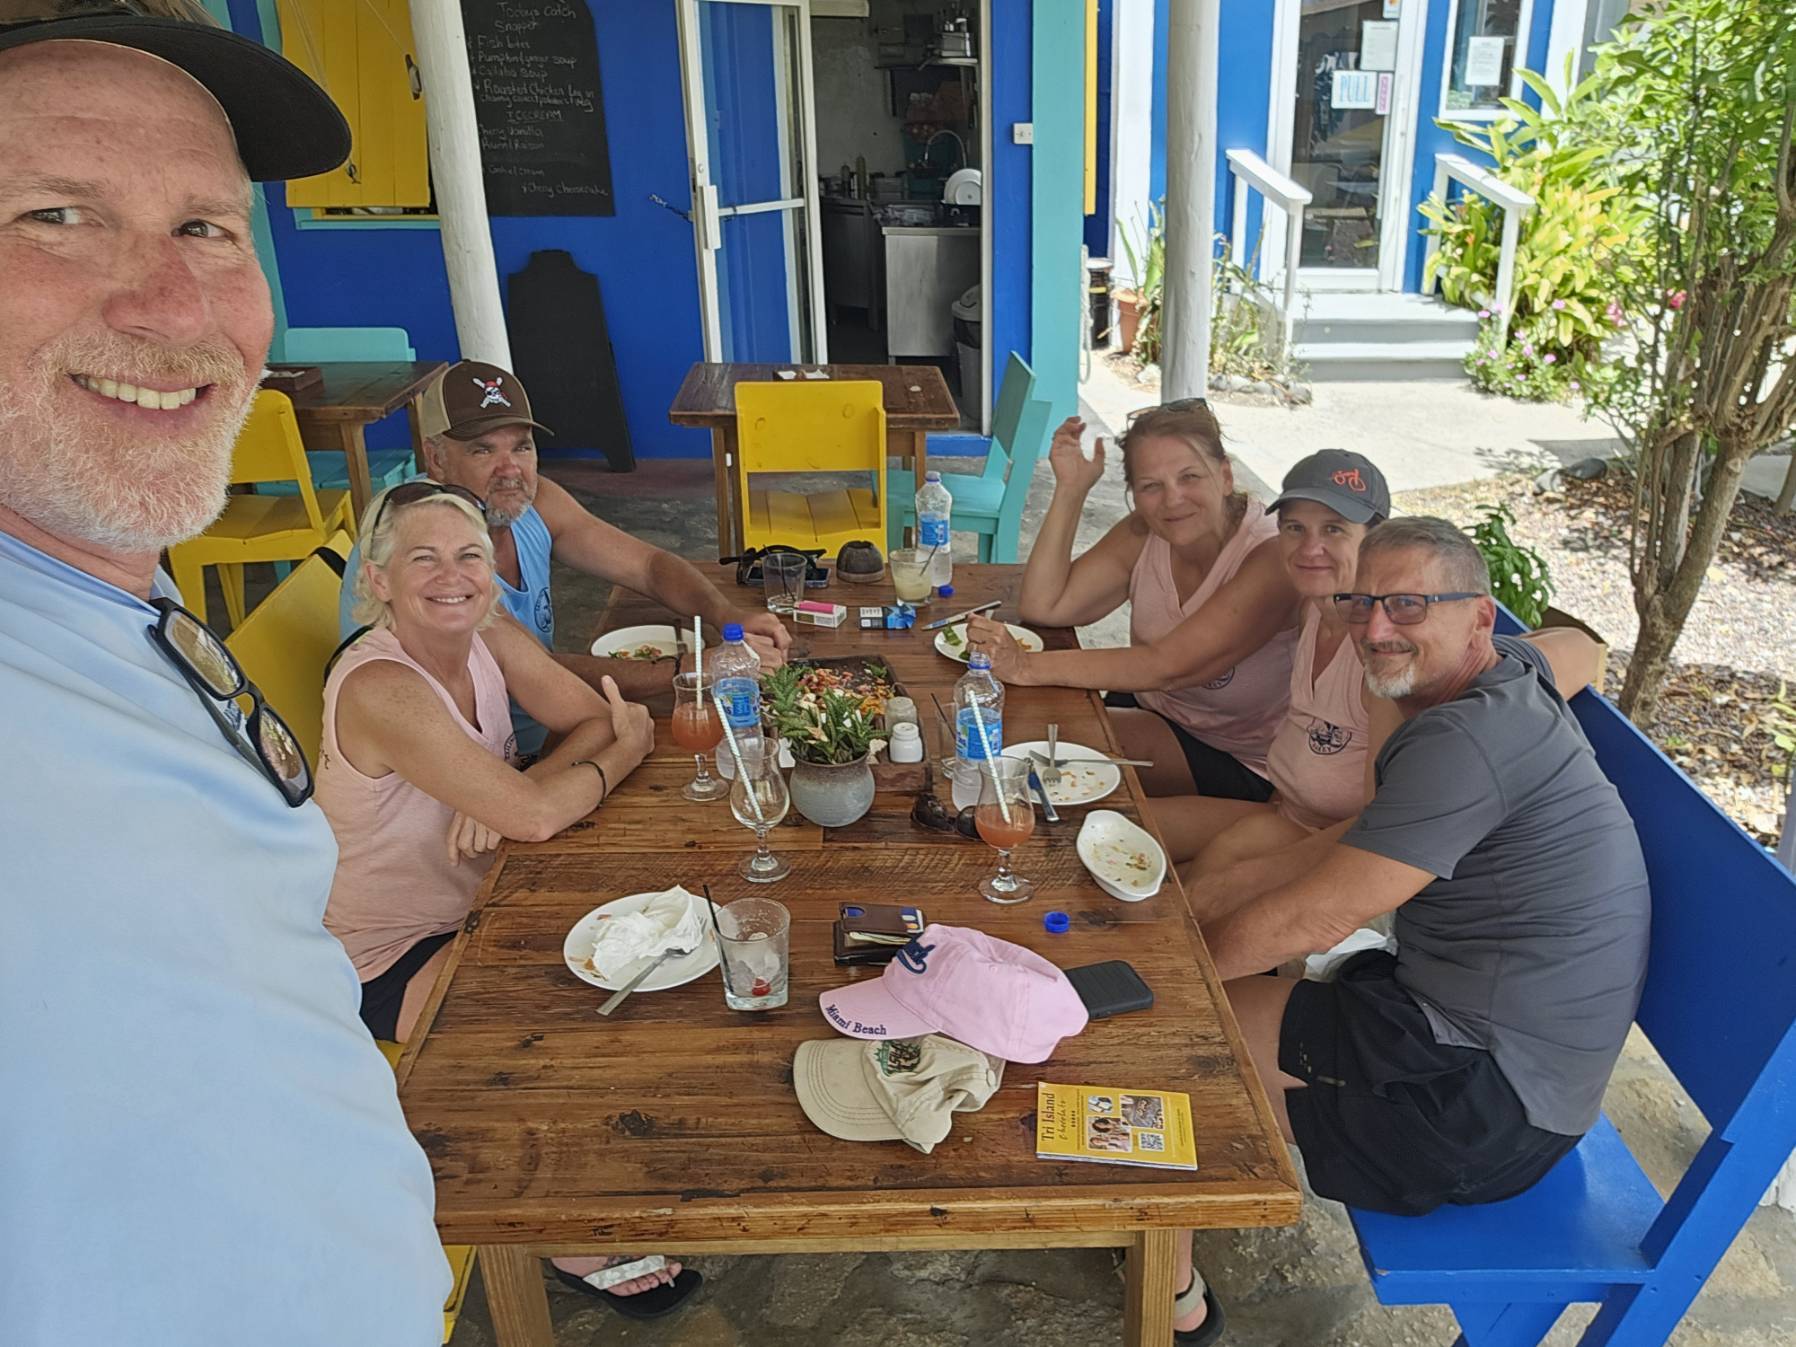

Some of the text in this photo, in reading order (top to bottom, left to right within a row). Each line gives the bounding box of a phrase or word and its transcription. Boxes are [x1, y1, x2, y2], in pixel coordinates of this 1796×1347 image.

[1339, 75, 1370, 103] PULL
[825, 1004, 887, 1036] Miami Beach
[1041, 1092, 1055, 1141] Tri Island
